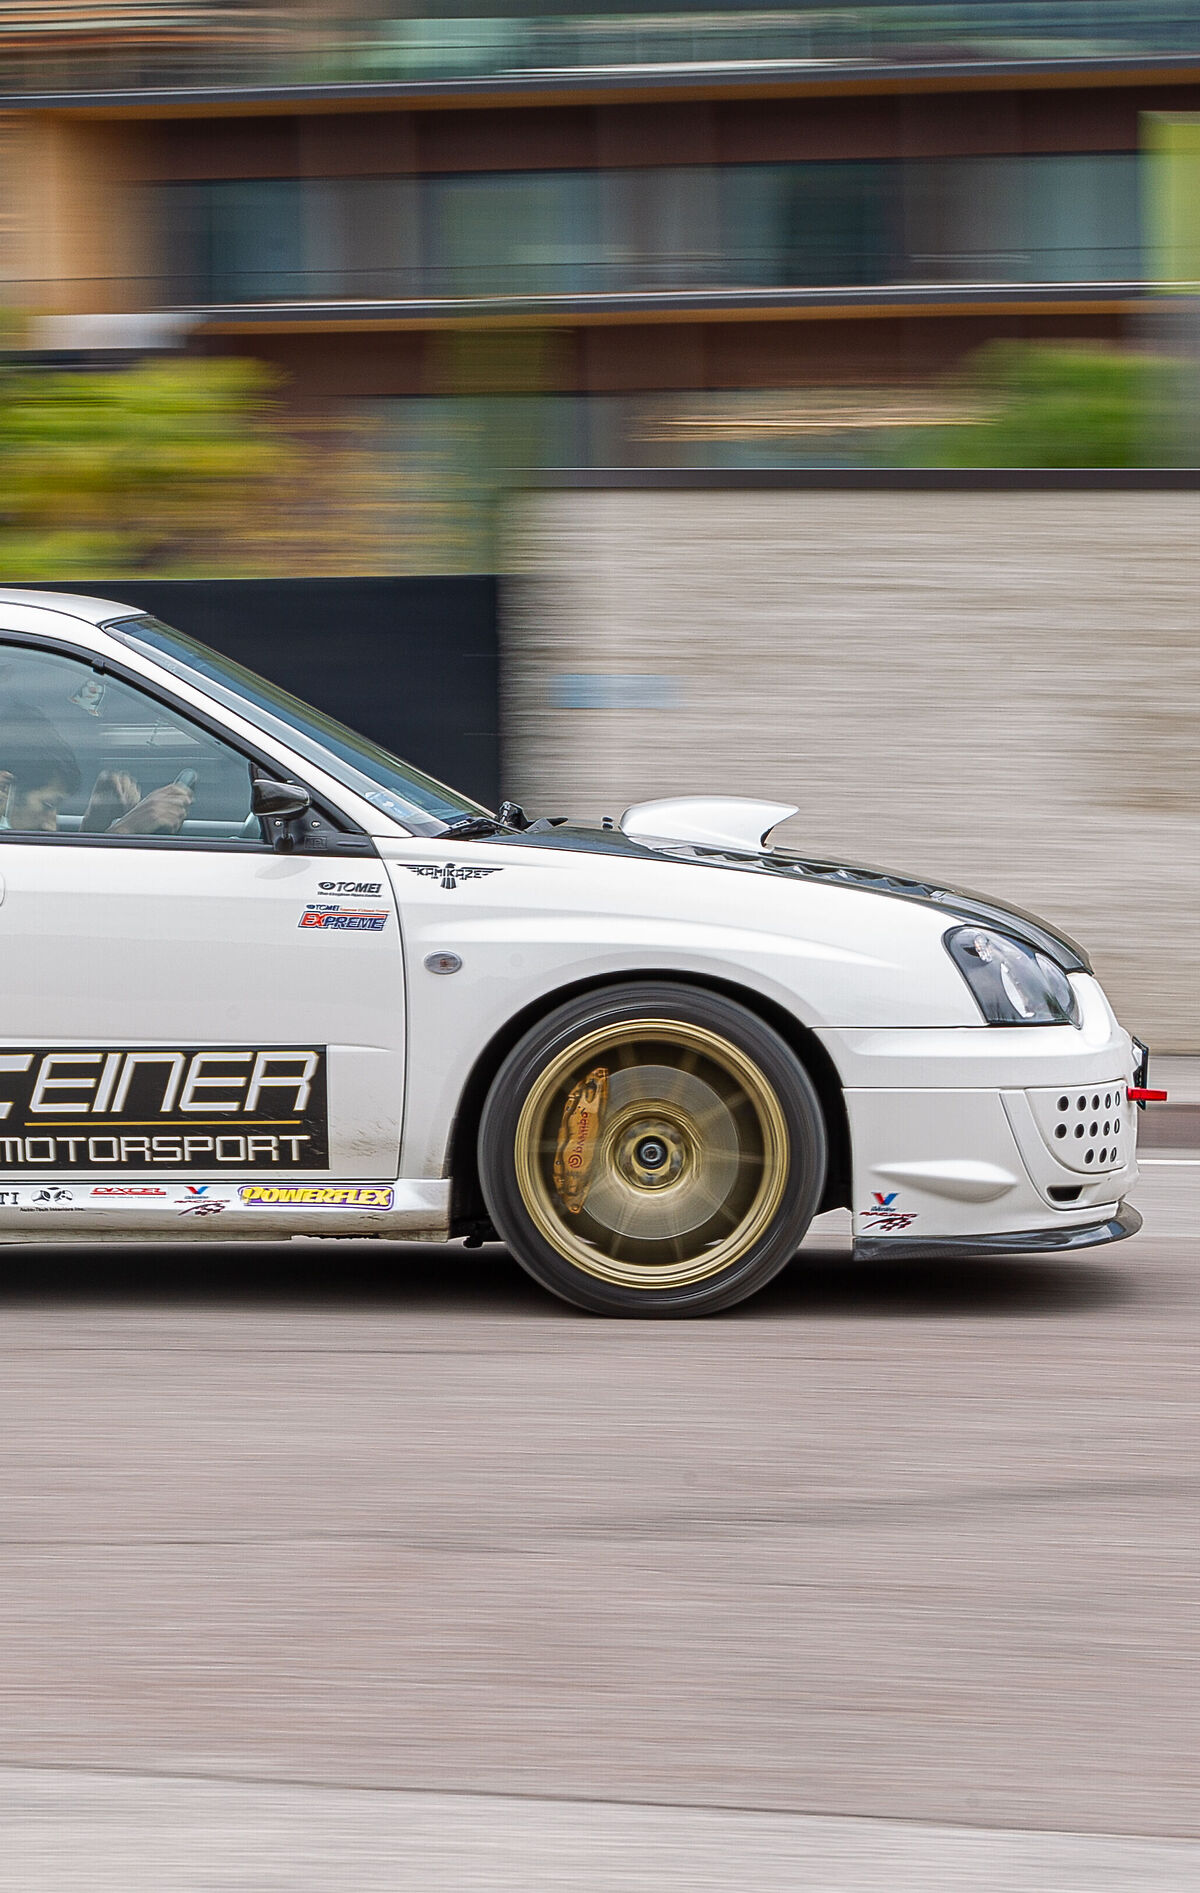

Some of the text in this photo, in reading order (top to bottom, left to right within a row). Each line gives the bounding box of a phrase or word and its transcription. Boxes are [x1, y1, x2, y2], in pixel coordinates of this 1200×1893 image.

[417, 868, 482, 880] KAMIKAZE
[337, 882, 382, 893] TOMEI
[301, 912, 385, 929] EXPREME
[241, 1186, 392, 1206] POWERFLEX
